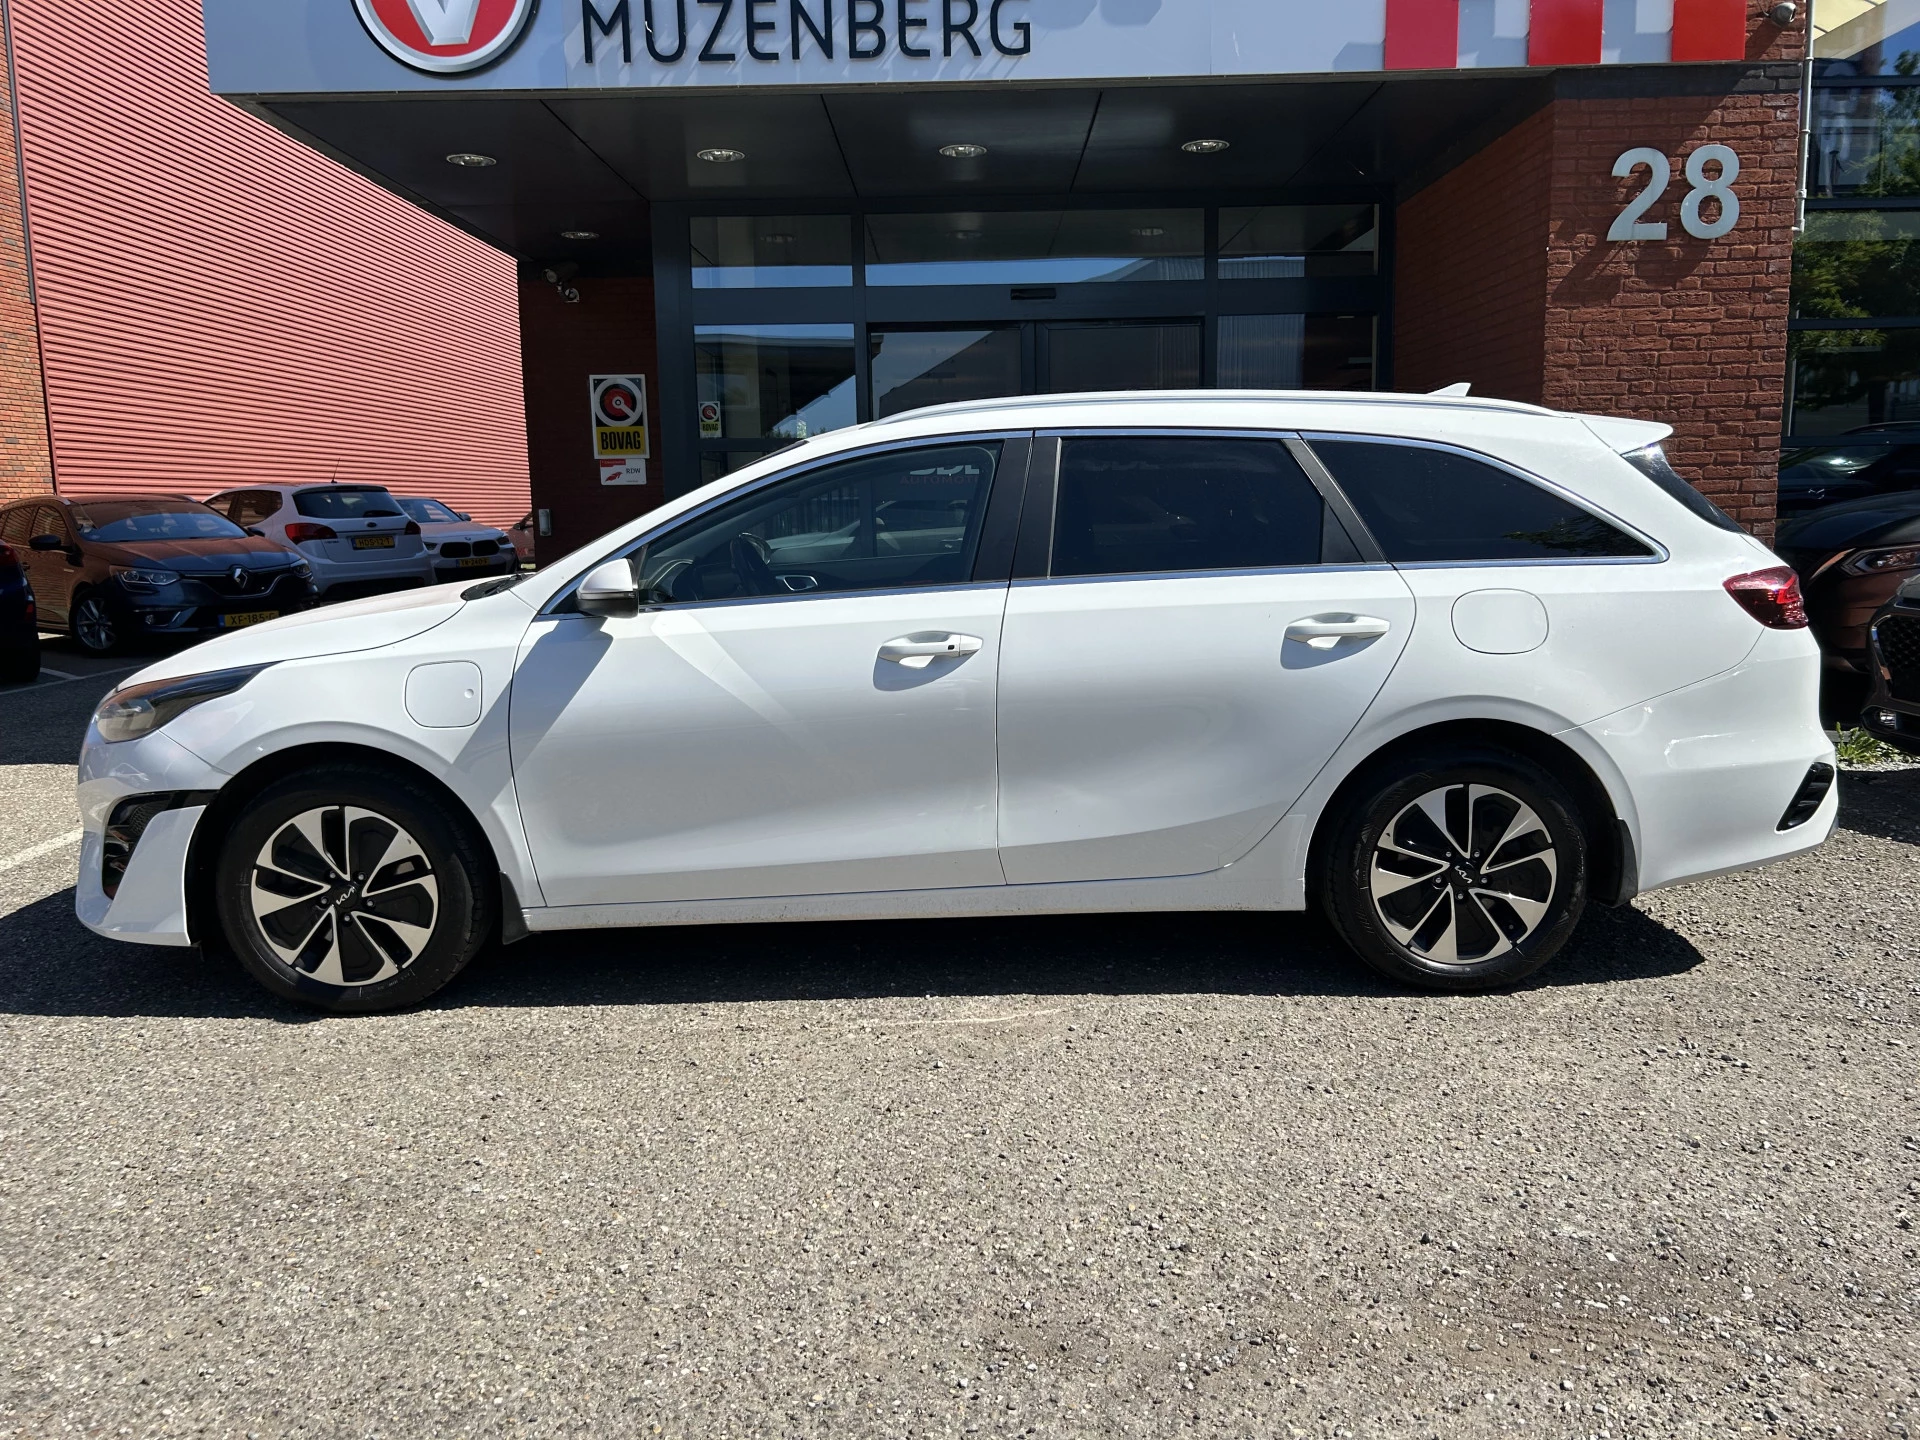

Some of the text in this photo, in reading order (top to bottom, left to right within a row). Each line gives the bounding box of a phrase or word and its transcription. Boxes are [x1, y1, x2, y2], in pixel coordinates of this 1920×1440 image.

[584, 0, 1031, 63] MUZENBERG
[1606, 144, 1740, 241] 28
[600, 431, 641, 450] BOVAG
[702, 423, 718, 431] BOVAG
